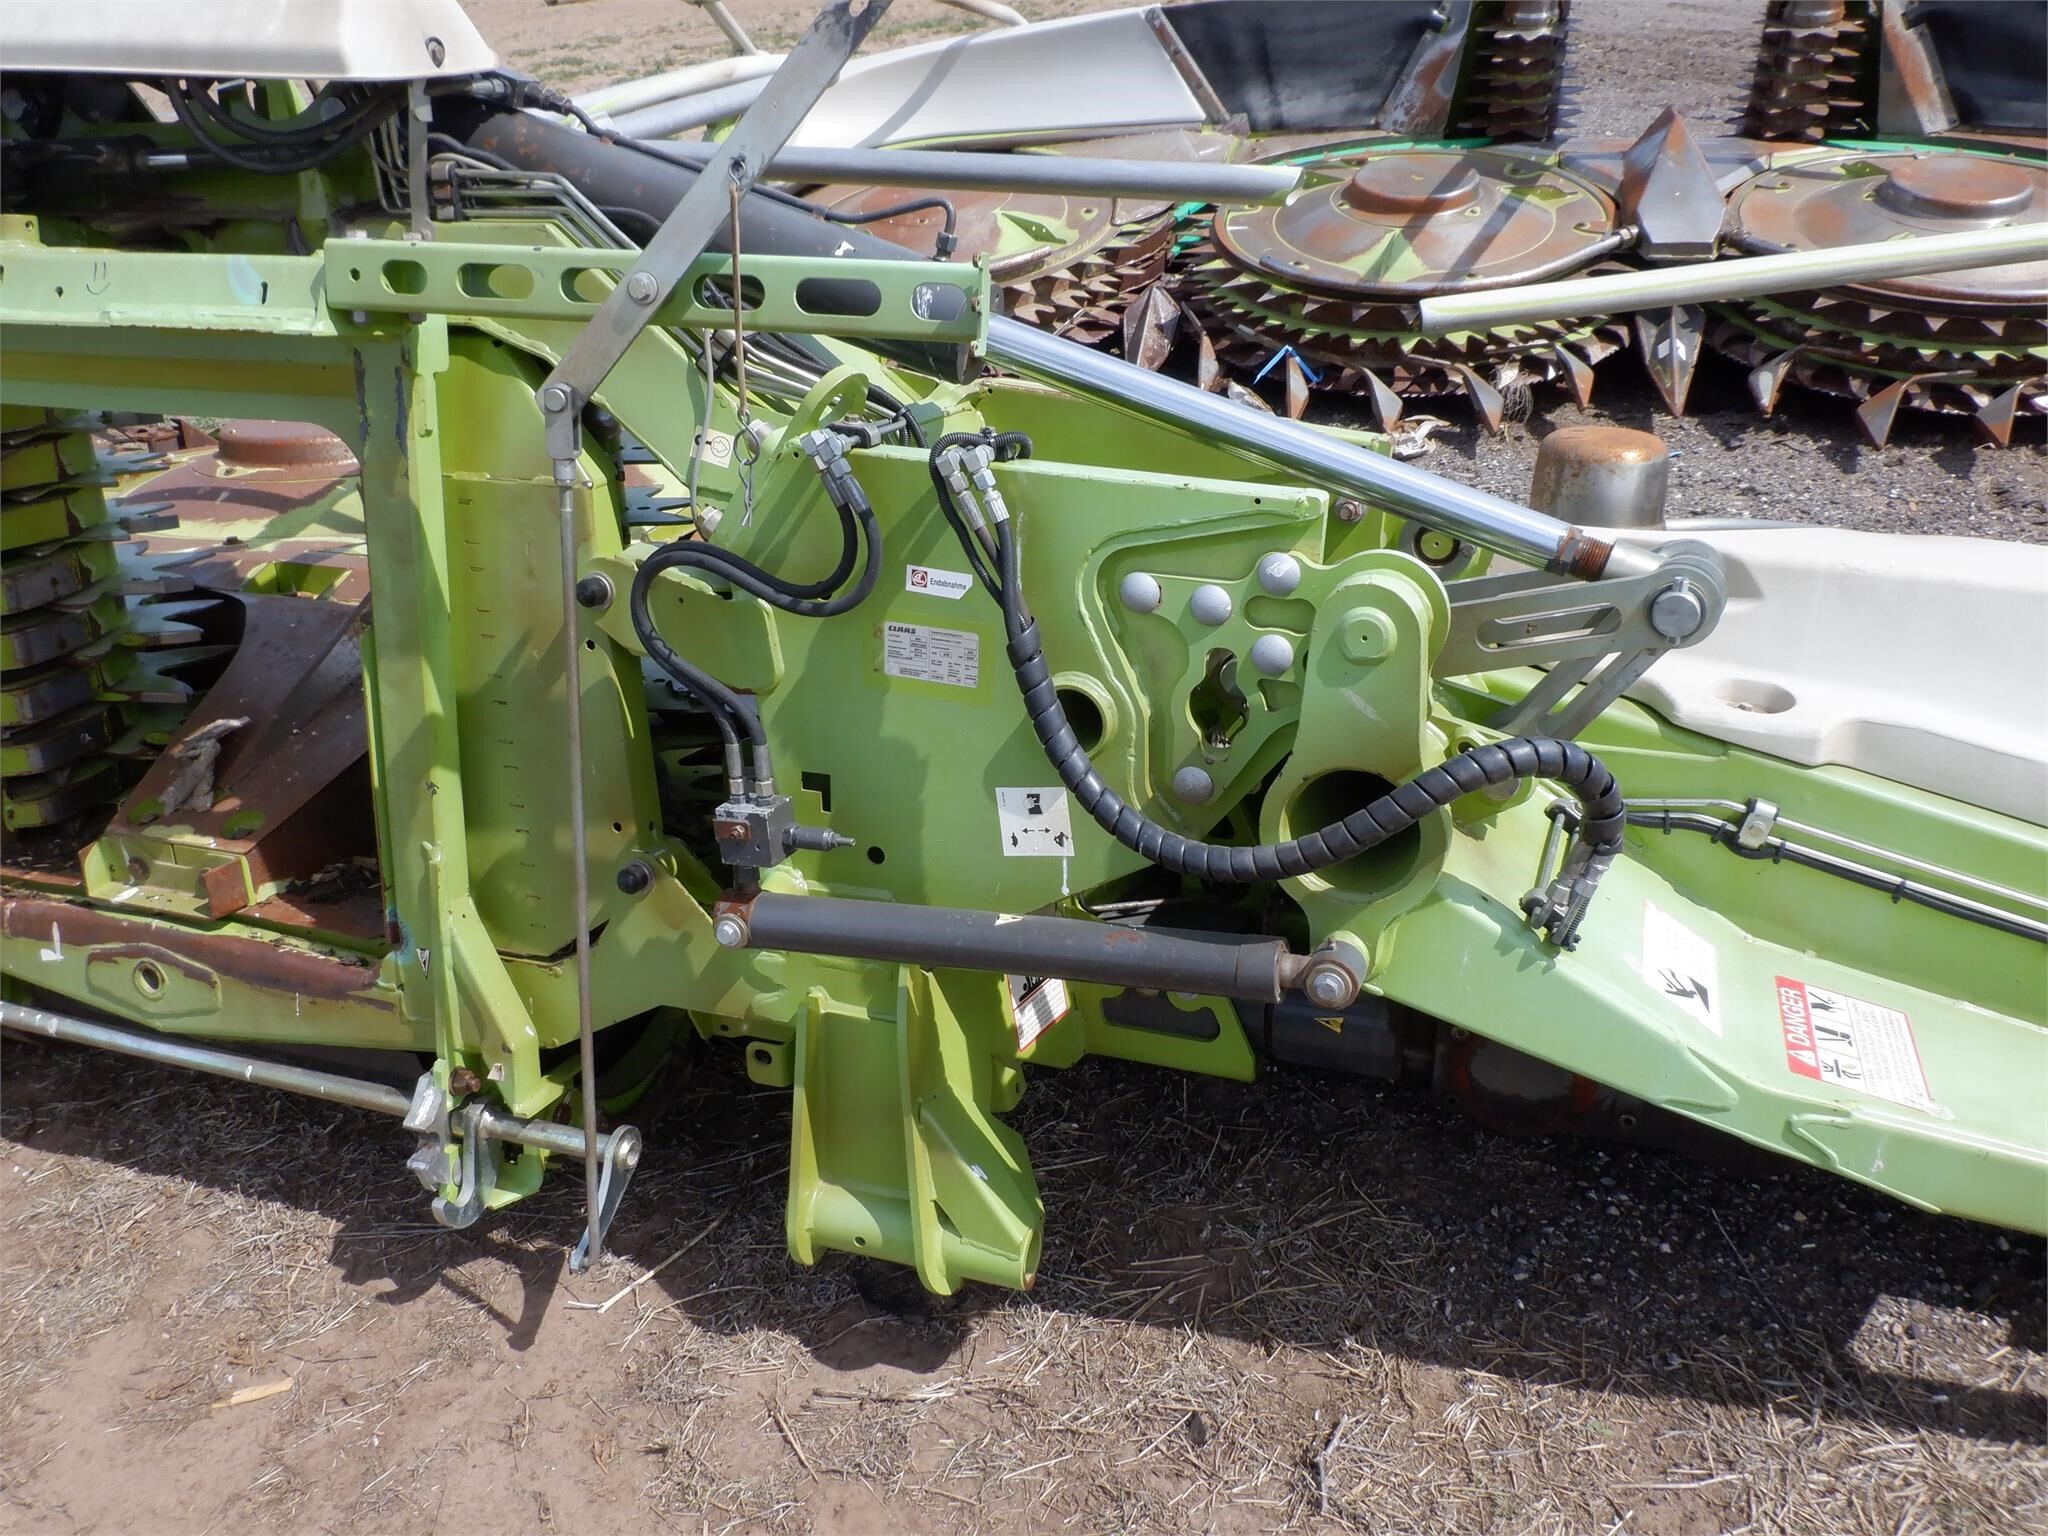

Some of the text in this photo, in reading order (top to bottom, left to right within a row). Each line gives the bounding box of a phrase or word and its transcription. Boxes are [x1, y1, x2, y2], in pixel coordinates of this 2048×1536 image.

[930, 578, 967, 590] Endabnahme
[888, 625, 916, 634] CLAAS
[1781, 987, 1811, 1047] DANGER
